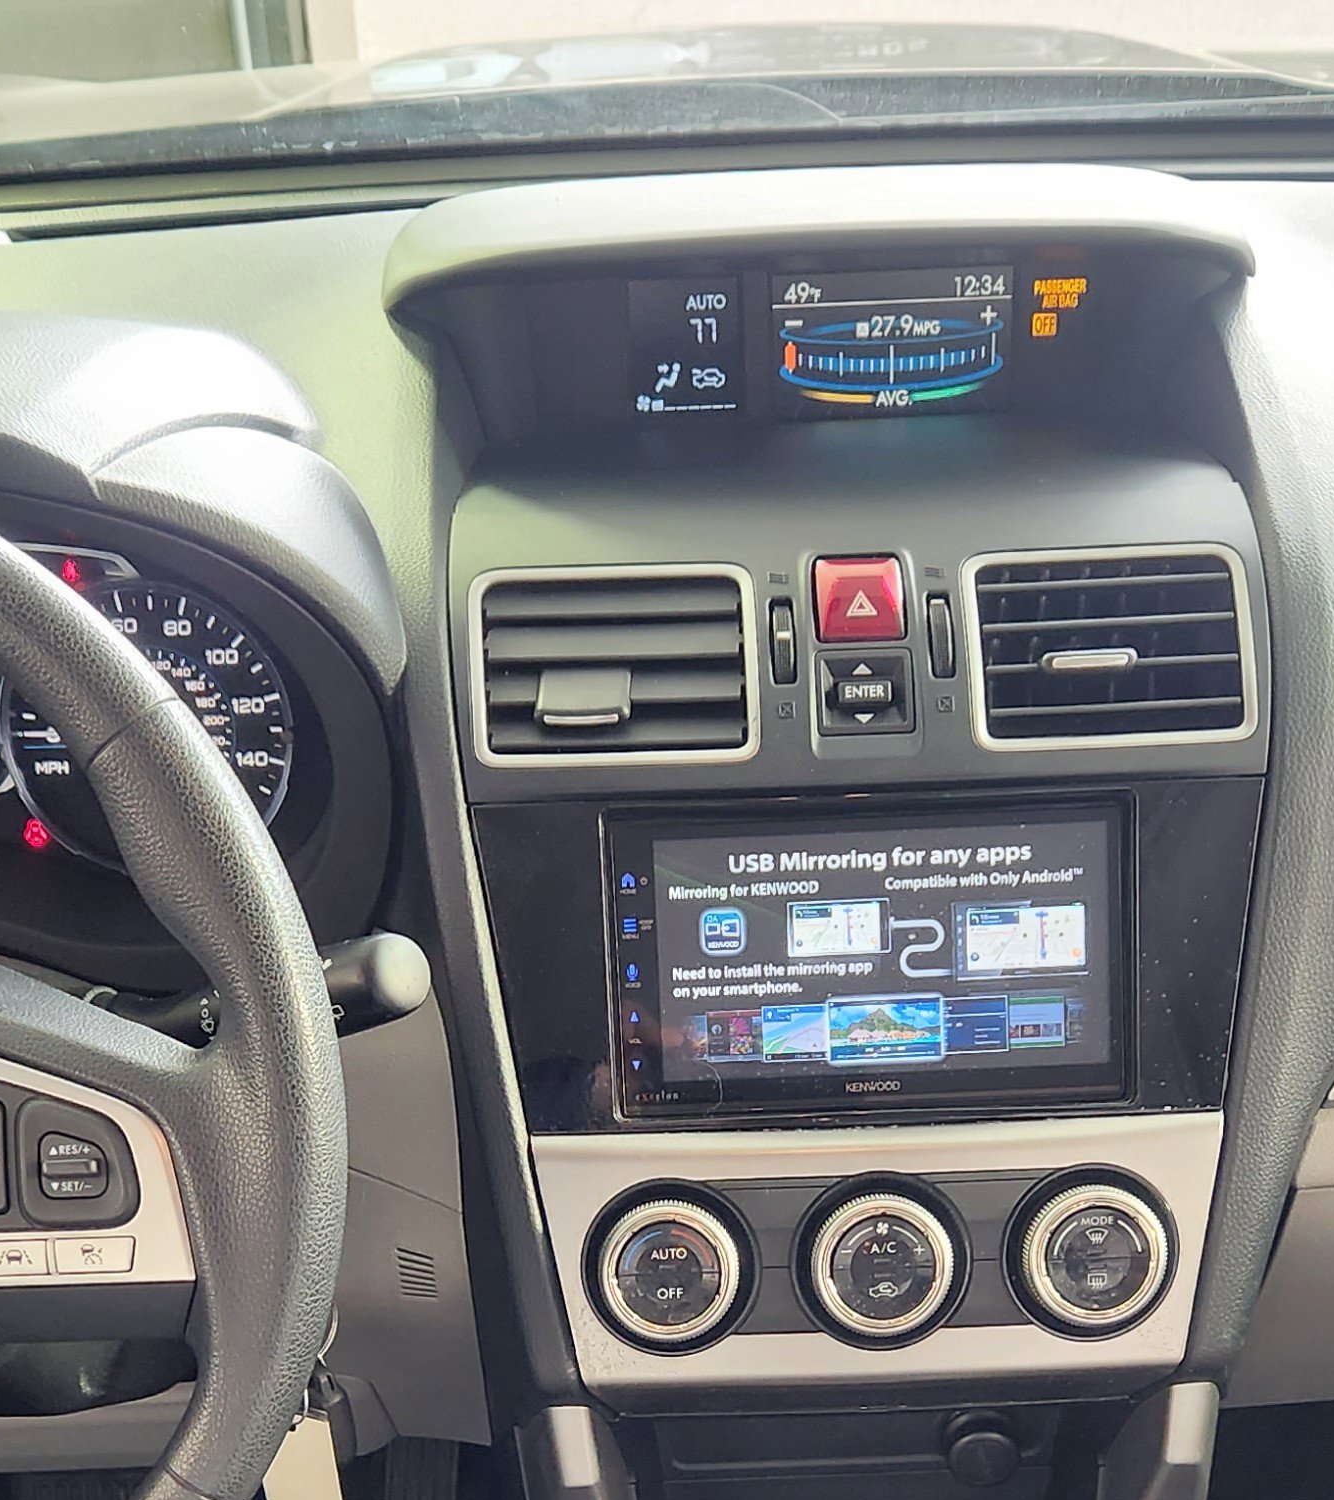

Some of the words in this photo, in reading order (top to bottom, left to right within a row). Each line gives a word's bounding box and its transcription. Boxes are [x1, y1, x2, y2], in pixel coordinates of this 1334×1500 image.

[953, 274, 1006, 298] 12:34
[1033, 277, 1087, 297] PASSENGER
[685, 292, 728, 312] AUTO
[1034, 316, 1055, 334] OFF
[875, 389, 912, 408] AVG.
[162, 620, 192, 637] 80
[204, 648, 238, 666] 100
[844, 684, 885, 699] ENTER
[231, 697, 265, 714] 120
[34, 760, 71, 776] MPH
[235, 750, 268, 768] 140
[727, 852, 775, 874] USB
[779, 848, 888, 873] Mirroring
[891, 847, 926, 868] for
[929, 847, 973, 868] any
[975, 844, 1032, 867] apps
[884, 874, 957, 892] Compatible
[958, 871, 988, 887] with
[989, 870, 1020, 888] Only
[667, 884, 729, 901] Mirroring
[729, 882, 749, 899] for
[750, 880, 819, 897] KENWOOD
[672, 967, 706, 981] Need
[707, 965, 722, 980] to
[723, 963, 762, 978] install
[763, 962, 786, 977] the
[787, 960, 847, 978] mirroring
[847, 960, 873, 975] app
[672, 986, 690, 998] on
[691, 985, 722, 1000] your
[722, 981, 803, 998] smartphone.
[844, 1080, 902, 1093] KENWOOD
[1080, 1215, 1115, 1226] MODE
[650, 1246, 688, 1261] AUTO
[869, 1241, 898, 1254] A/C
[656, 1287, 685, 1300] OFF
